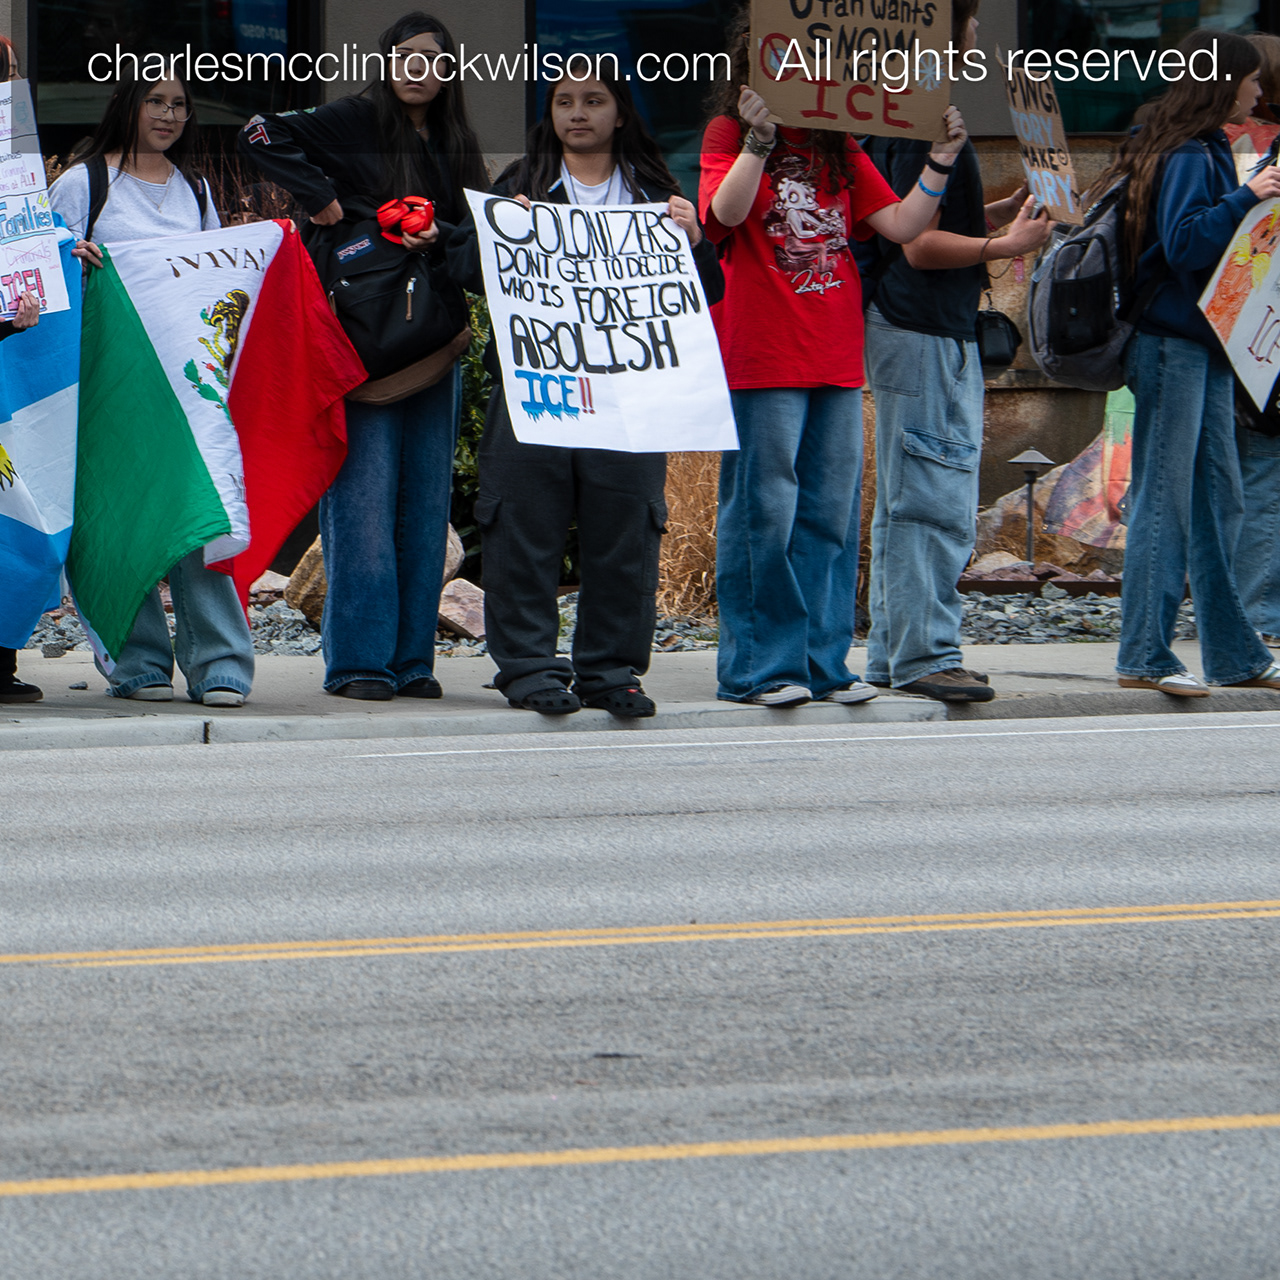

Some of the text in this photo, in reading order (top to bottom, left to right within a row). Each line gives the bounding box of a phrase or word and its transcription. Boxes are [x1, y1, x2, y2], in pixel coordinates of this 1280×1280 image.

[806, 22, 916, 60] SNOW
[799, 76, 915, 129] ICE
[484, 197, 682, 259] COLONIZERS
[493, 241, 690, 283] DONT GET TO DECIDE
[499, 274, 701, 325] WHO IS FOREIGN
[510, 313, 680, 375] ABOLISH
[515, 370, 596, 418] ICE!!
